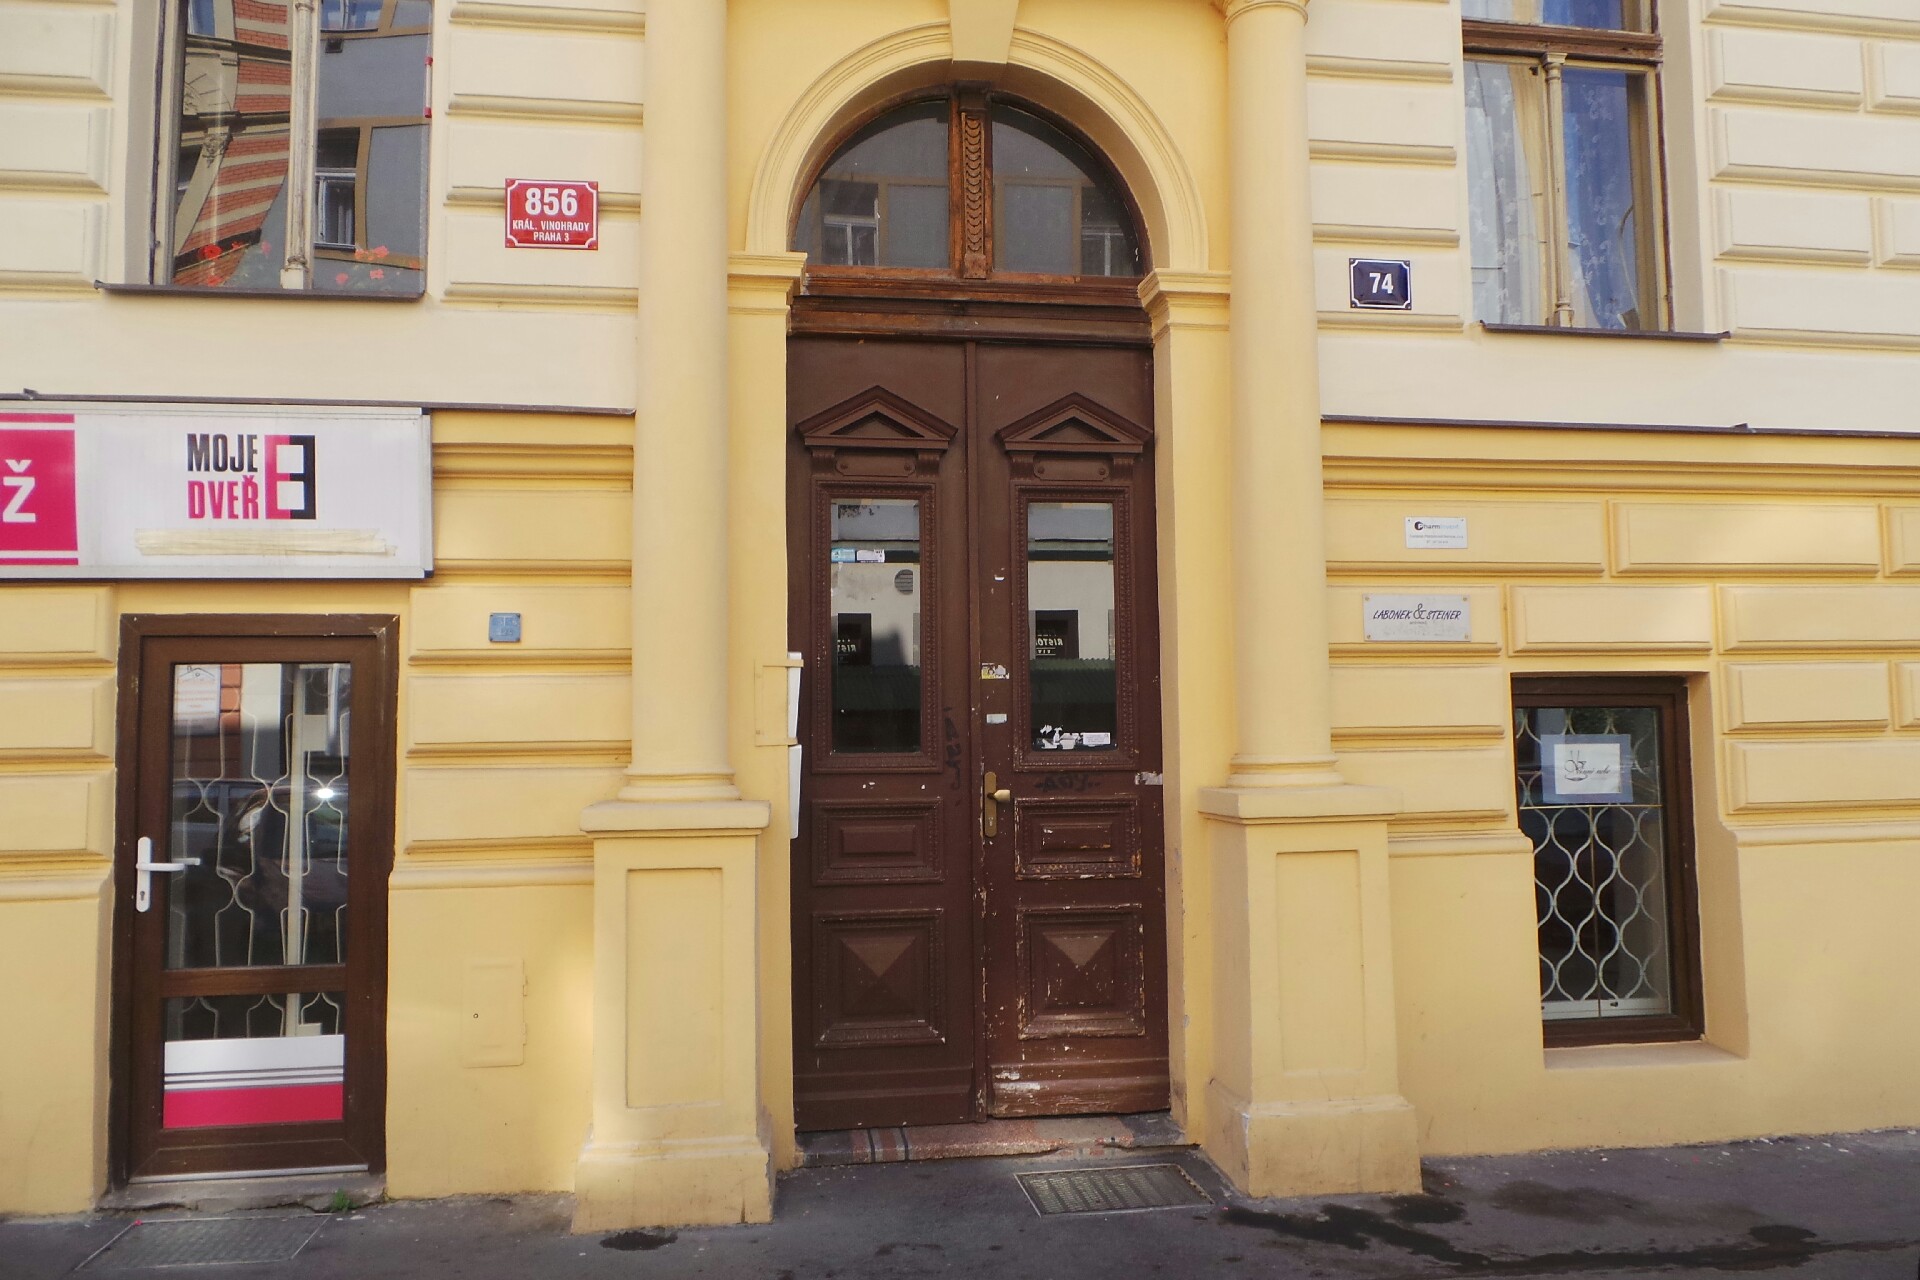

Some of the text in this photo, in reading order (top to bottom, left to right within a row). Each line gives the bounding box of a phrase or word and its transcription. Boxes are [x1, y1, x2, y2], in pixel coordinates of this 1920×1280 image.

[525, 187, 578, 216] 856
[512, 218, 590, 232] KRÁL. VINOHRADY
[533, 231, 570, 242] PRAHA 3
[1369, 272, 1394, 294] 74
[187, 433, 258, 472] MOJE
[1426, 610, 1462, 620] STEINER
